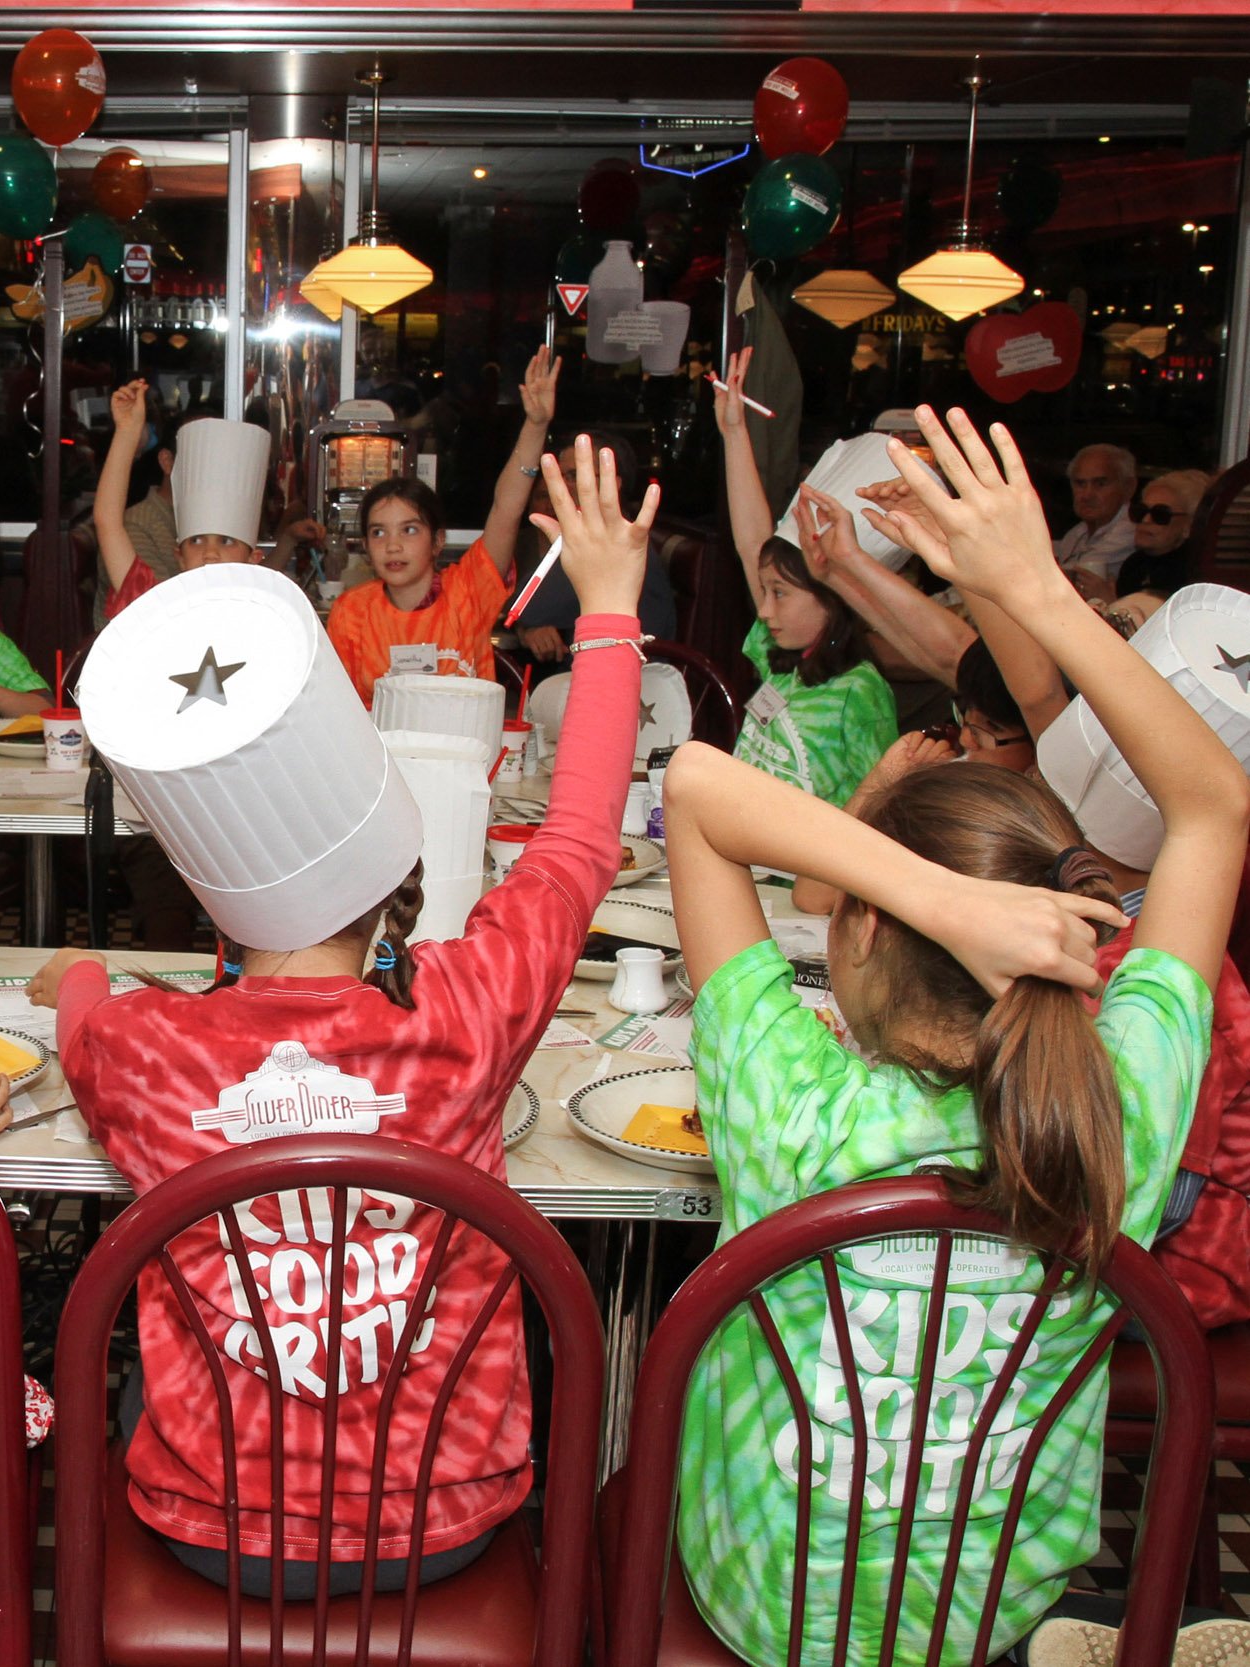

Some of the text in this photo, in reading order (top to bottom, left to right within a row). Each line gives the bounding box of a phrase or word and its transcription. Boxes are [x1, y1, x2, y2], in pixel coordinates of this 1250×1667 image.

[793, 973, 830, 988] HONES
[241, 1082, 354, 1134] SILVER DINER
[682, 1195, 711, 1216] 53
[224, 1232, 420, 1318] FOOD
[881, 1263, 913, 1273] LOCALLY
[956, 1263, 1000, 1274] OPERATED
[814, 1361, 1028, 1441] FOOD
